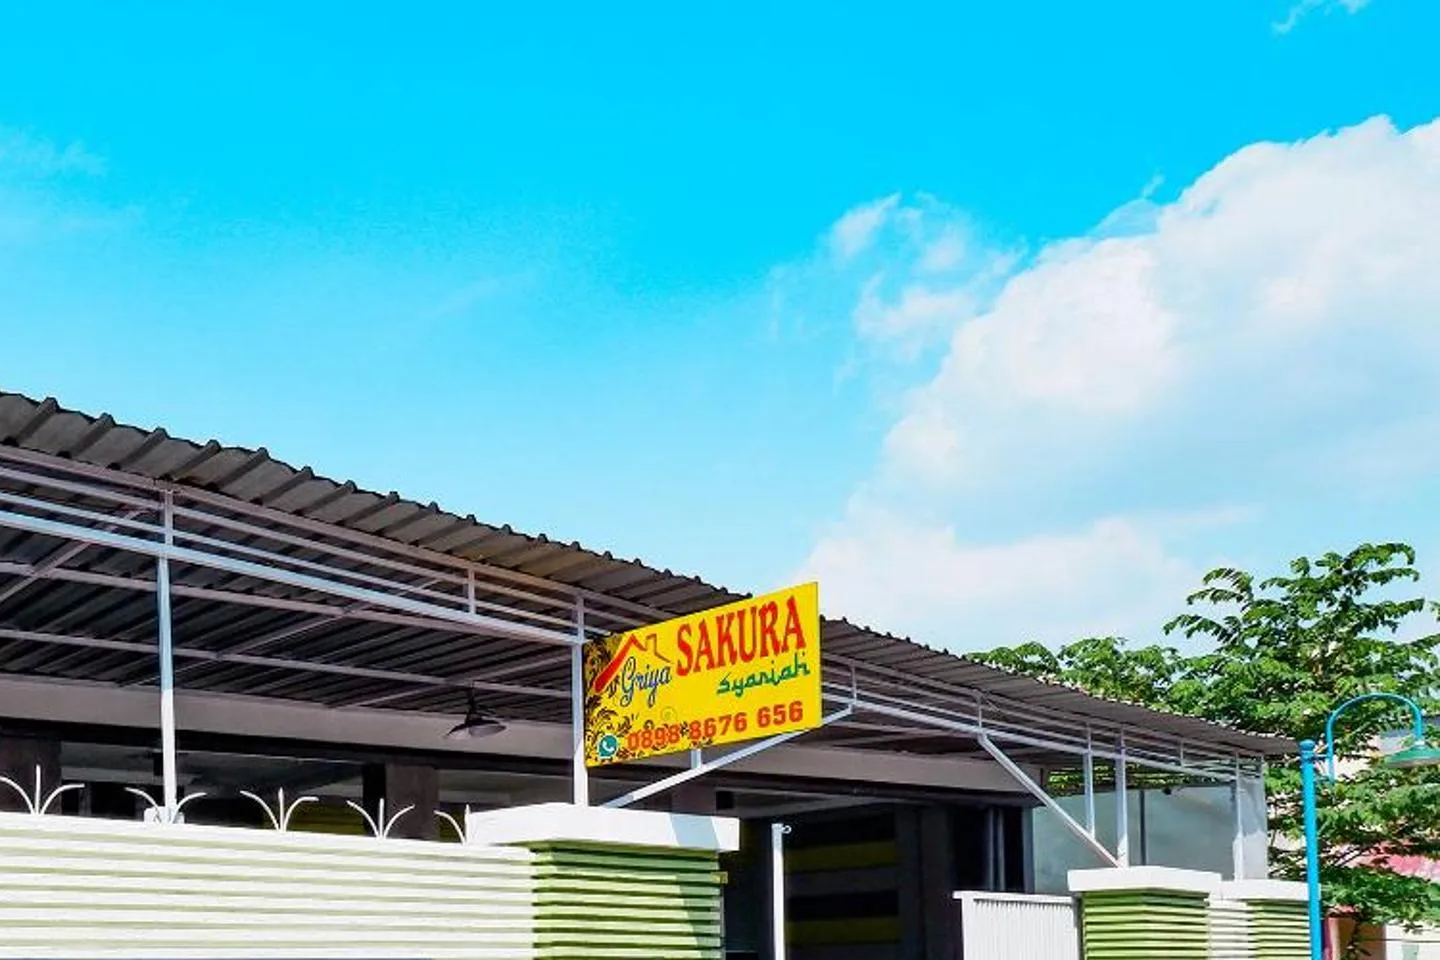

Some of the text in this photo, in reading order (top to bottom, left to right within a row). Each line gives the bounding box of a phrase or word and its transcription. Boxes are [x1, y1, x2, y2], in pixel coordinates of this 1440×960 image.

[620, 595, 806, 708] Griya SAKURA
[627, 700, 803, 750] 0898 8676 656
